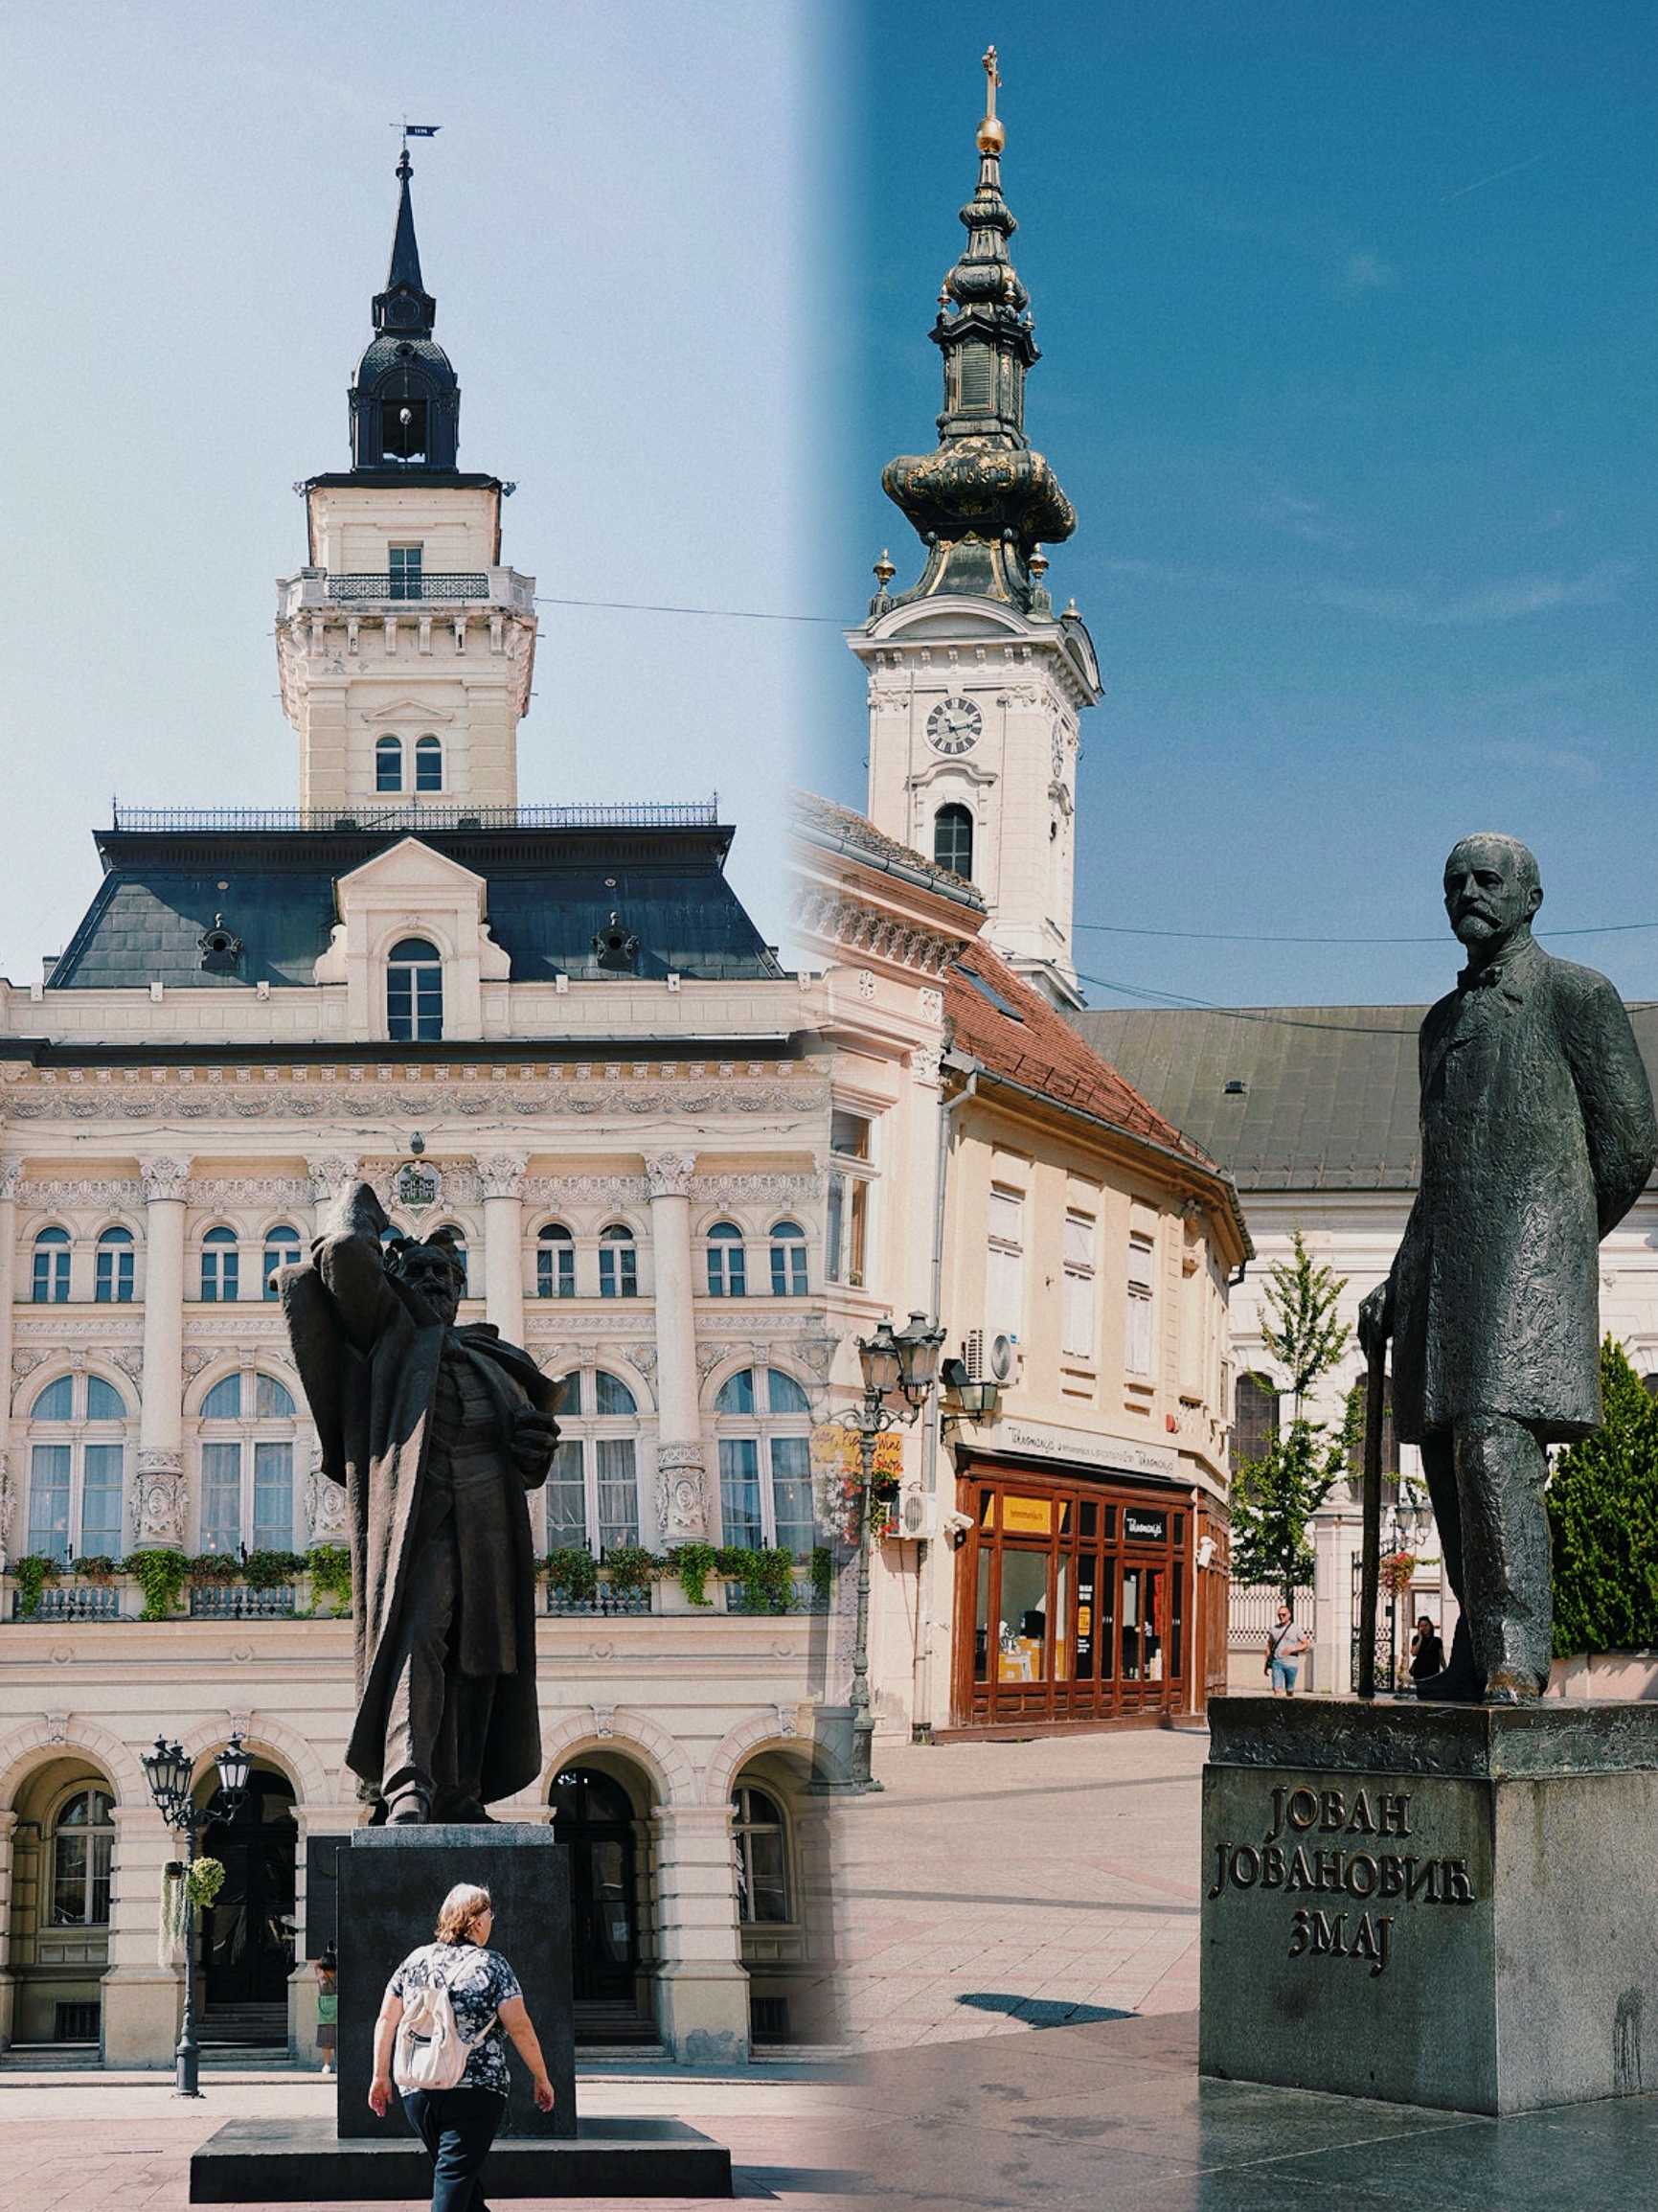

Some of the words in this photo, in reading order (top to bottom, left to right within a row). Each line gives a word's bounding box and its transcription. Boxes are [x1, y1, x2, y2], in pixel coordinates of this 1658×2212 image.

[1265, 1785, 1412, 1842] ЈОВАН
[1209, 1842, 1475, 1904] ЈОВАНОВИЋ
[1289, 1907, 1395, 1977] ЗМАЈ
